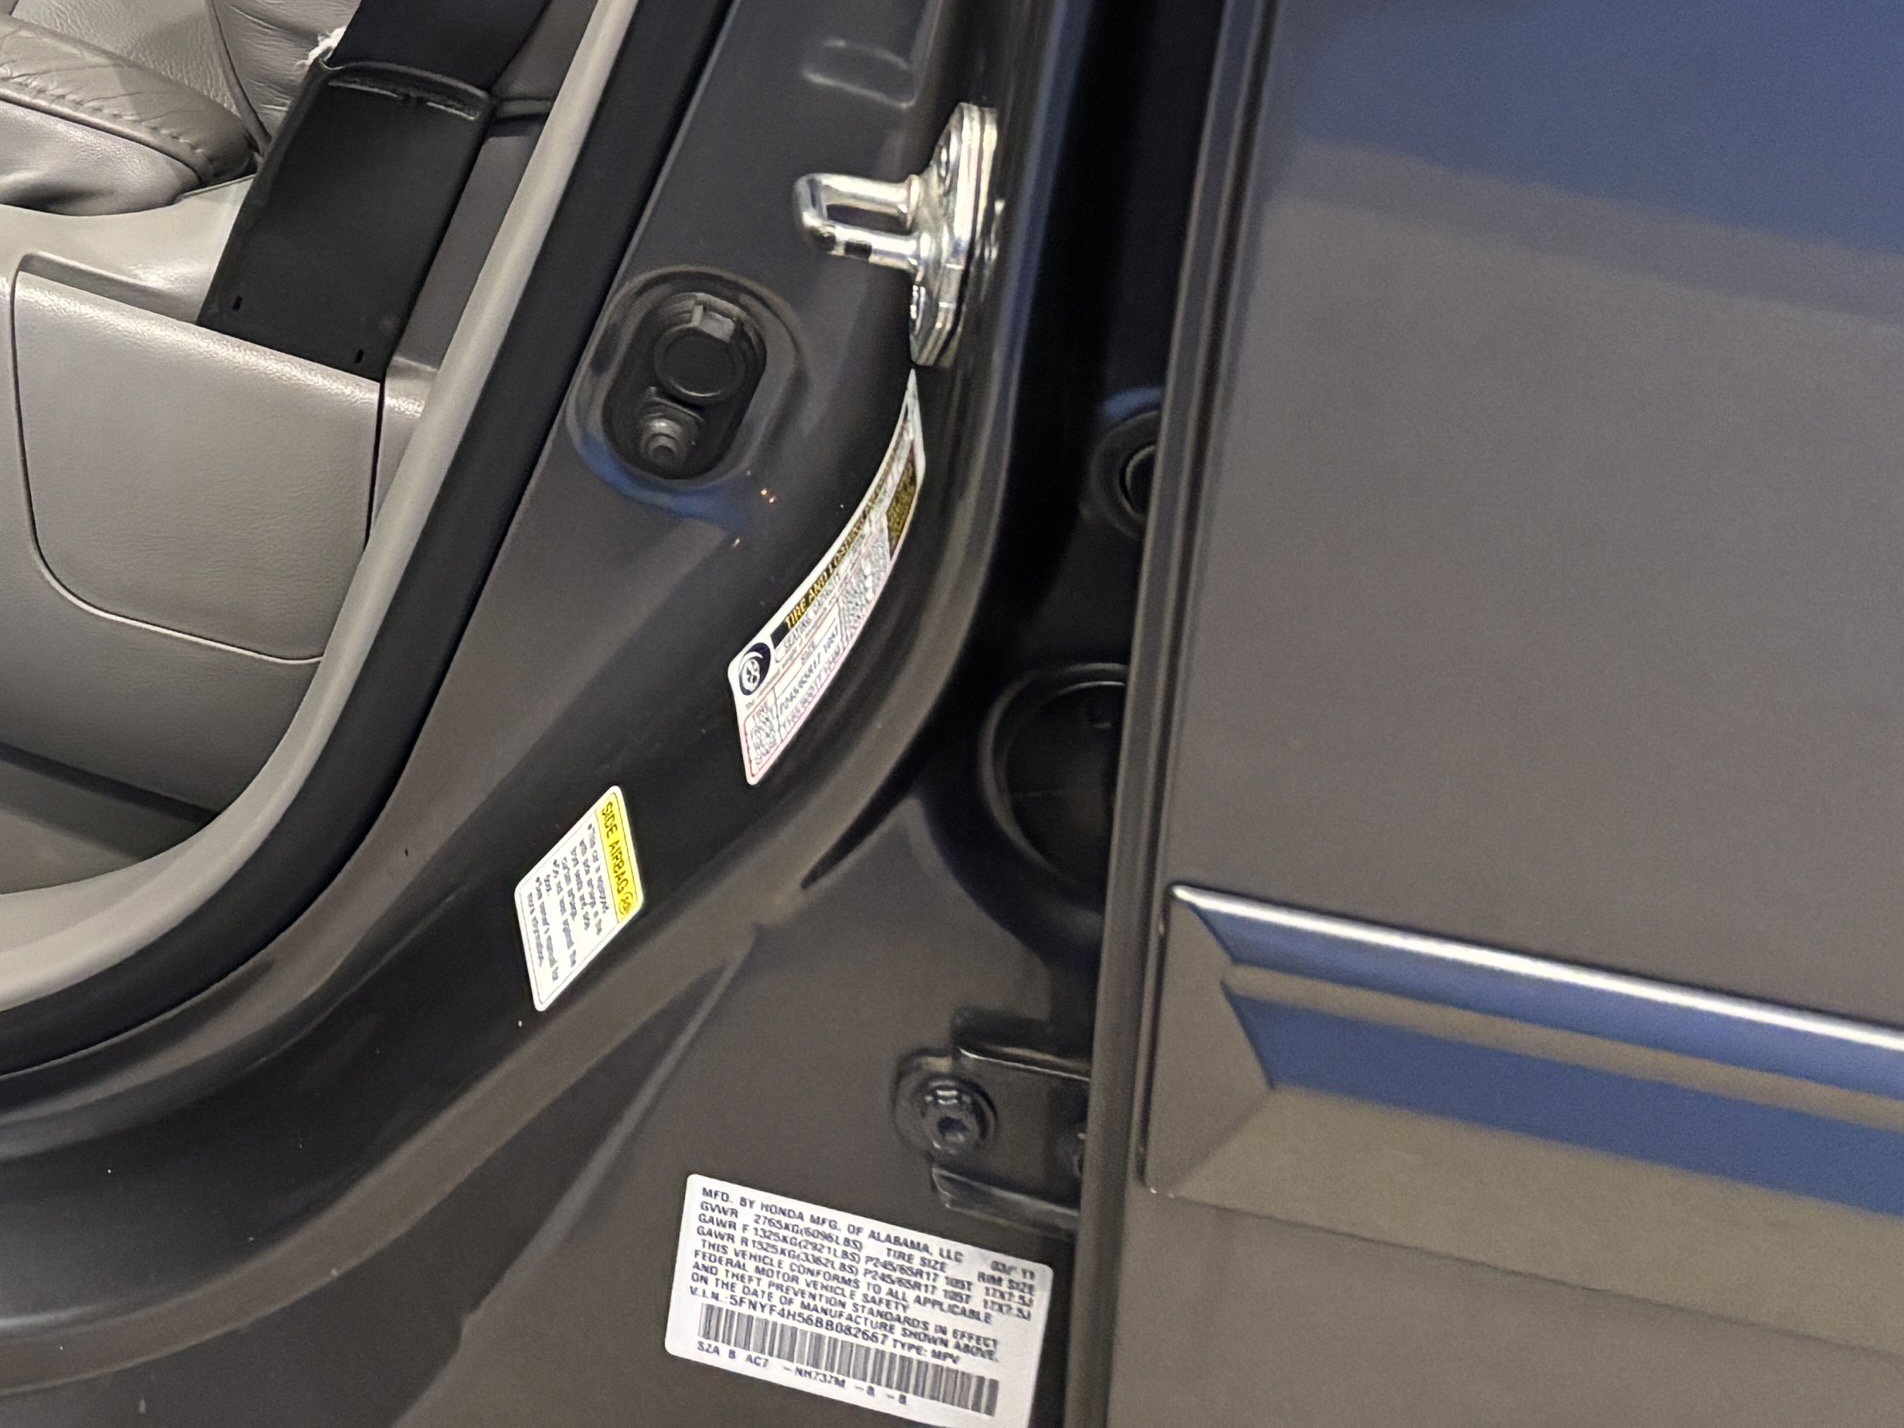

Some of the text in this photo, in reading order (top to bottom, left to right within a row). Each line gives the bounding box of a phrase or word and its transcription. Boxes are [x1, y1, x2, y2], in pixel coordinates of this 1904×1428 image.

[695, 1223, 736, 1244] GAWR
[739, 1235, 749, 1248] R
[697, 1210, 738, 1232] GAWR
[741, 1222, 750, 1235] F
[699, 1198, 740, 1220] GVWR
[884, 1246, 914, 1264] TIRE
[918, 1255, 948, 1273] SIZE
[738, 1195, 755, 1210] BY
[759, 1200, 805, 1223] HONDA
[846, 1223, 864, 1238] OF
[937, 1246, 964, 1264] LLC
[690, 1271, 709, 1286] ON
[713, 1277, 737, 1294] THE
[741, 1284, 774, 1303] DATE
[778, 1293, 794, 1308] OF
[798, 1299, 896, 1334] MANUFACTURE
[900, 1325, 950, 1348] SHOWN
[691, 1260, 999, 1349] AND THEFT PREVENTION STANDARDS IN EFFECT
[693, 1248, 910, 1314] FEDERAL MOTOR VEHICLE SAFETY
[699, 1238, 993, 1324] THIS VEHICLE CONFORMS TO ALL APPLICABLE
[929, 1347, 961, 1365] MPV
